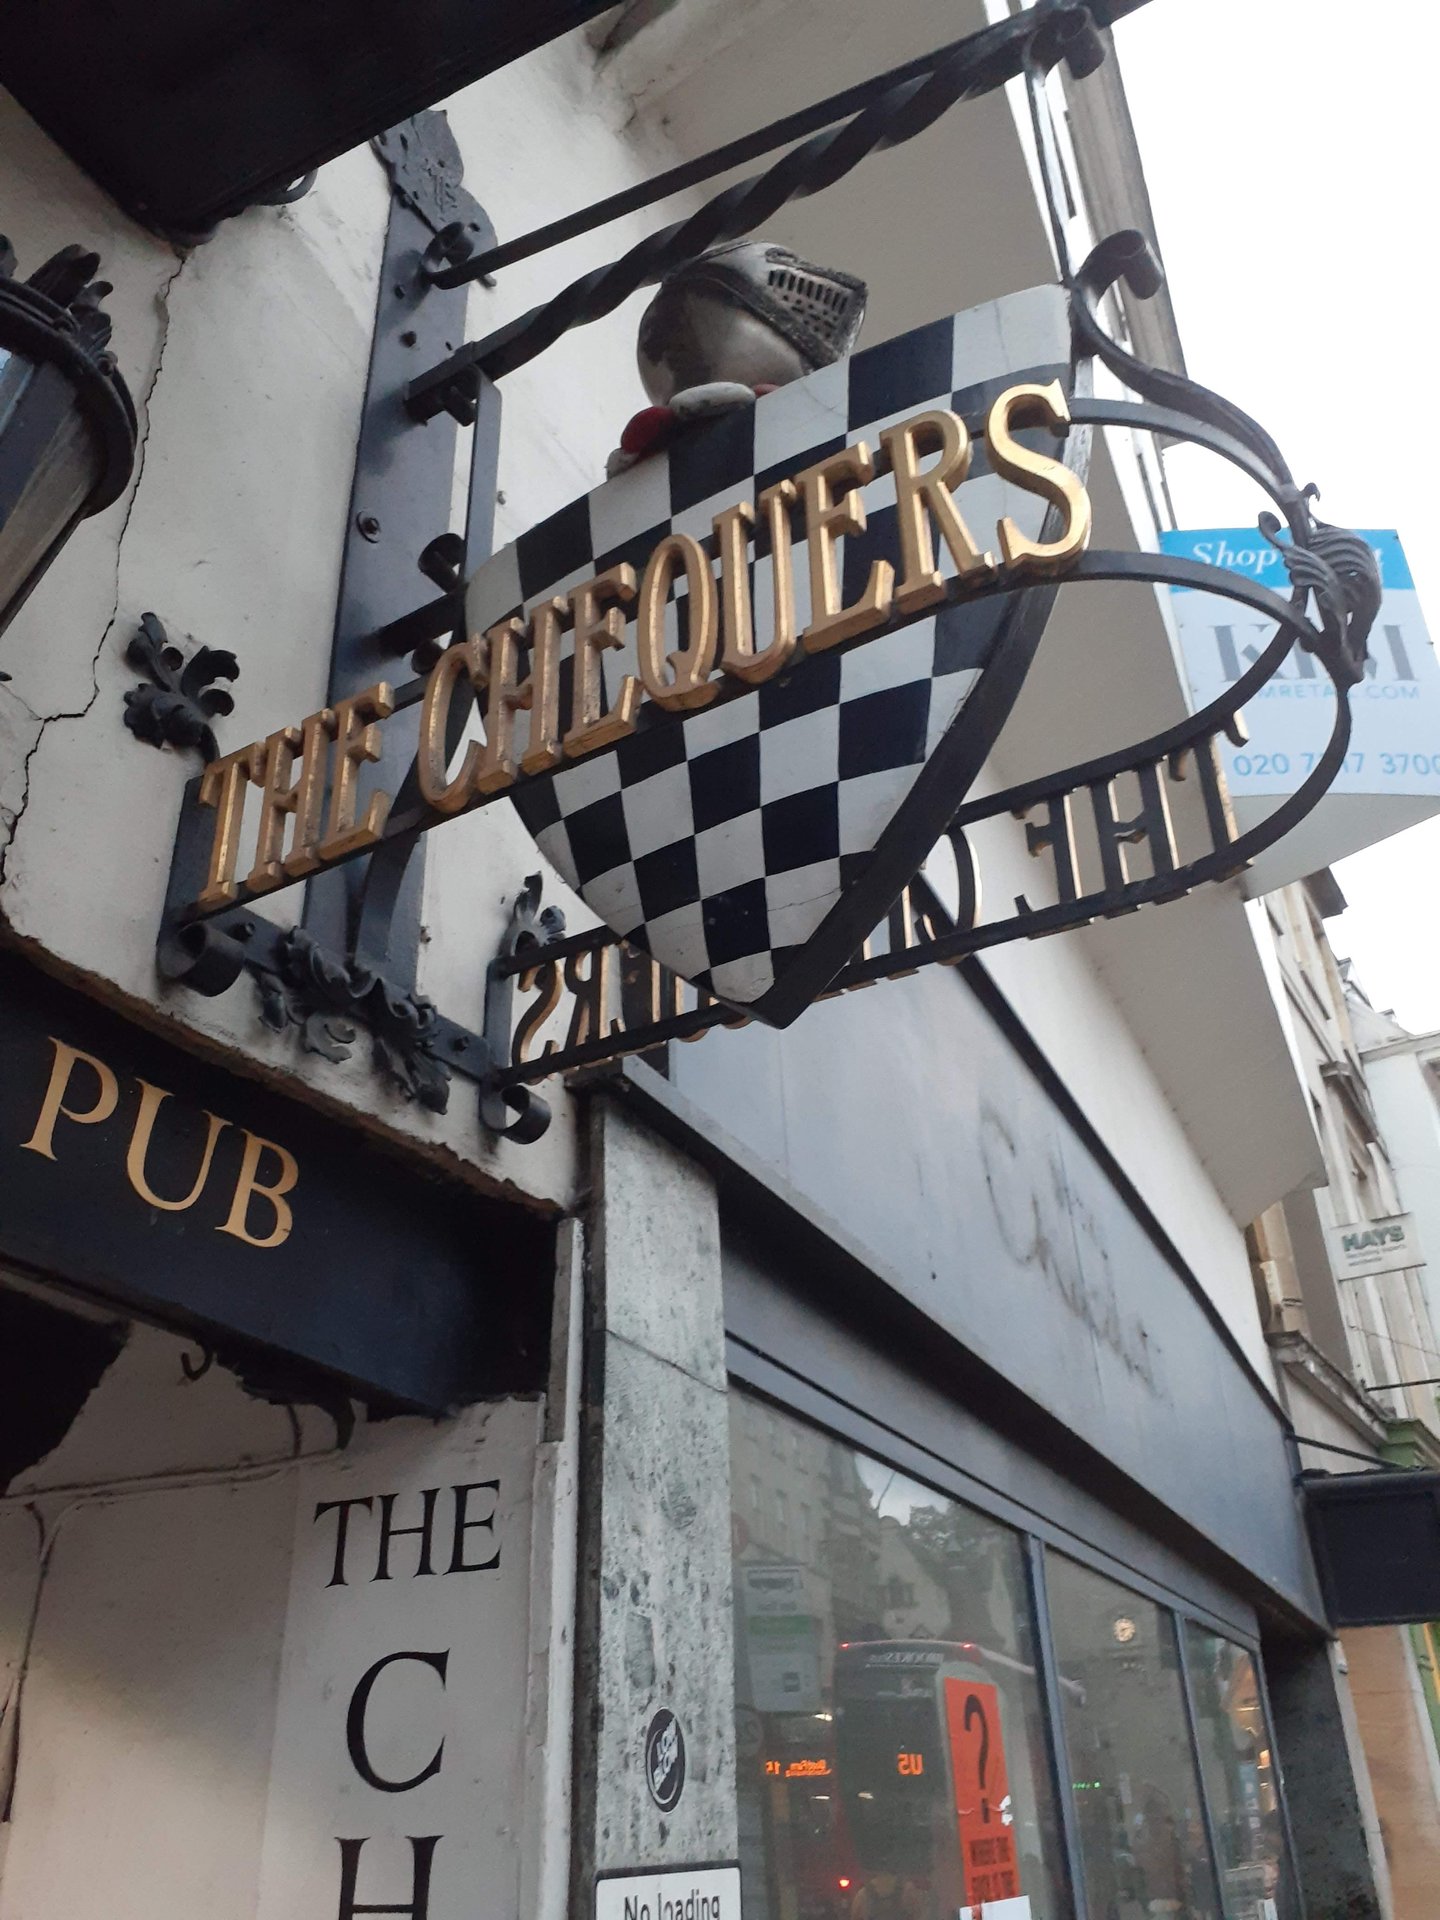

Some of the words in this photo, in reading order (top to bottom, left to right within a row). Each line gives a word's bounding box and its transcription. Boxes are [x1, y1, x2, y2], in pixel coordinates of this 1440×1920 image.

[1192, 540, 1278, 575] Shop
[199, 681, 395, 909] THE
[418, 378, 1094, 814] CHEQUERS
[1232, 752, 1290, 777] 020
[1300, 752, 1365, 775] 77
[20, 1036, 301, 1249] PUB
[1342, 1225, 1405, 1252] HAYS
[313, 1479, 501, 1589] THE
[624, 1895, 651, 1920] No
[658, 1889, 721, 1920] loading
